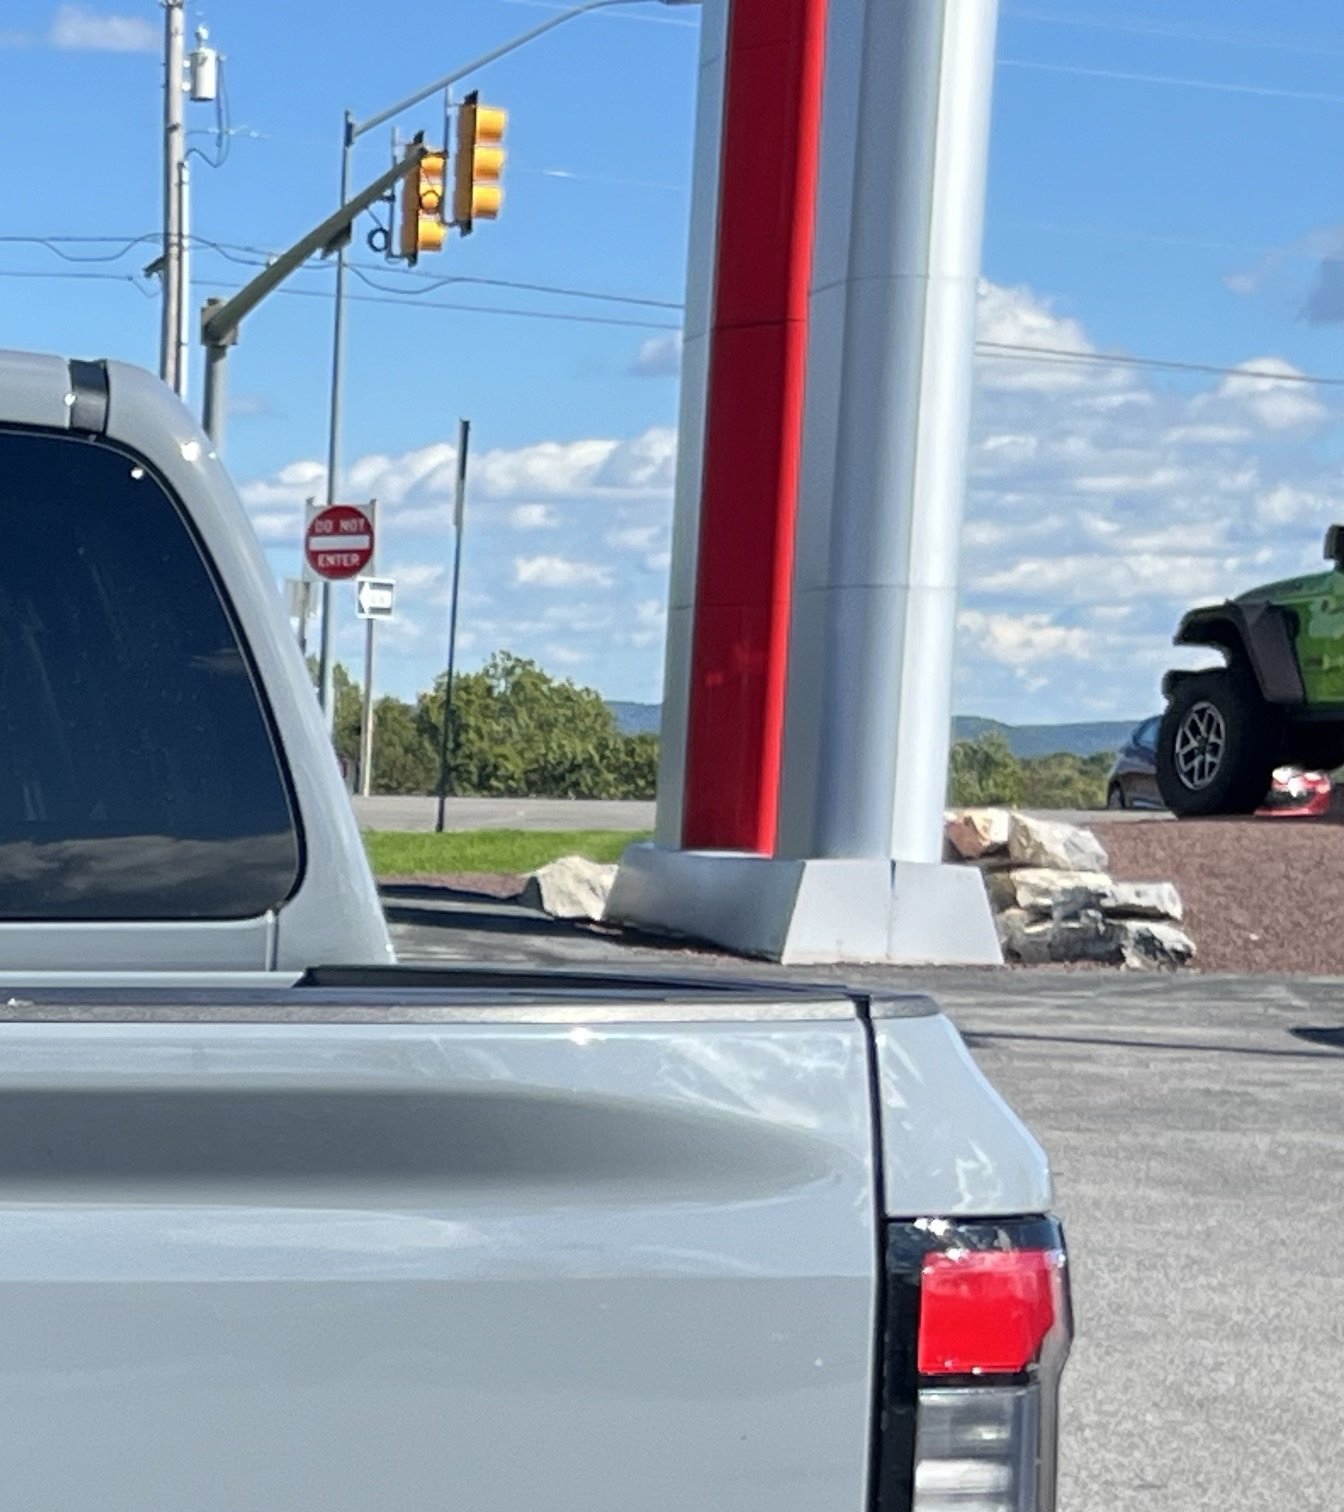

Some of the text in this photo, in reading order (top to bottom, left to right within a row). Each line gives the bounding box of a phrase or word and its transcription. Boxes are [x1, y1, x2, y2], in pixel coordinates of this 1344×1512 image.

[315, 518, 365, 534] DO NOT
[318, 553, 361, 568] ENTER
